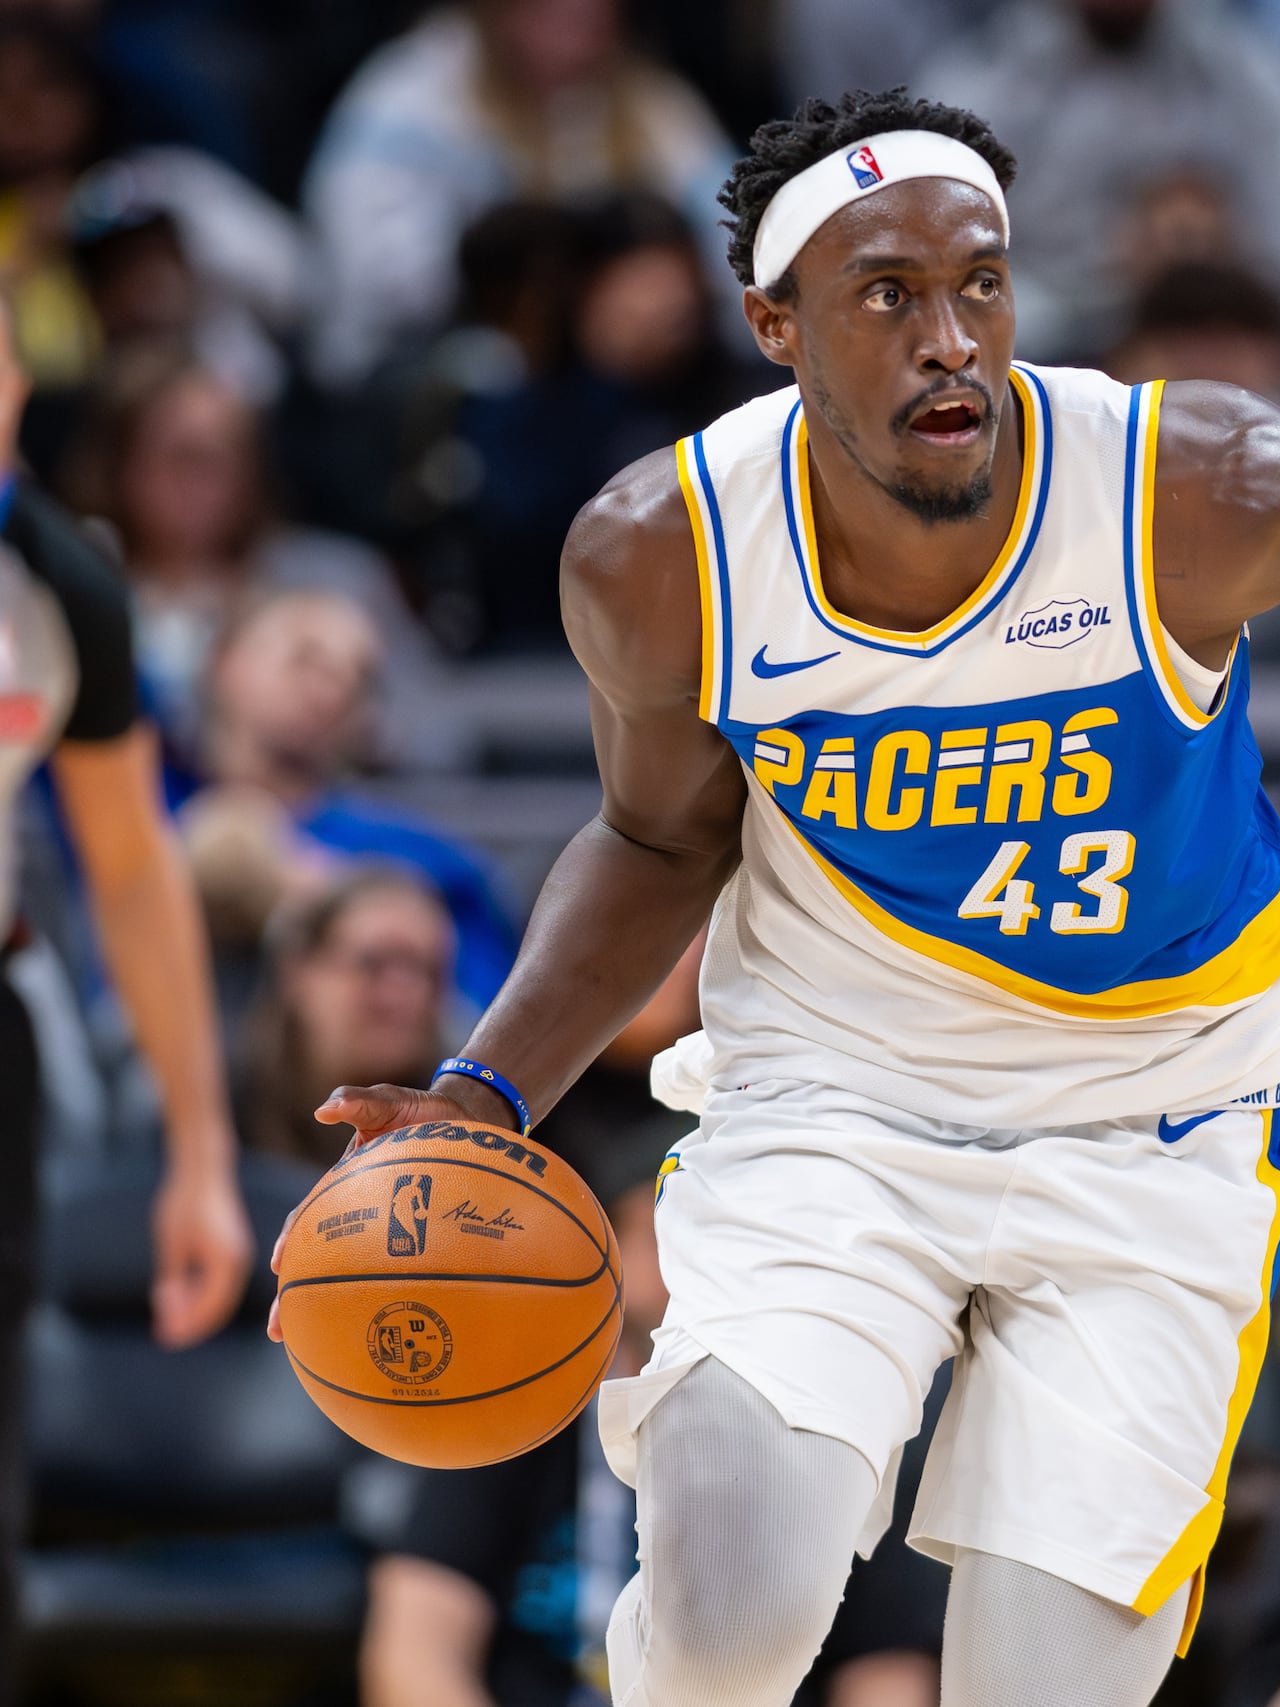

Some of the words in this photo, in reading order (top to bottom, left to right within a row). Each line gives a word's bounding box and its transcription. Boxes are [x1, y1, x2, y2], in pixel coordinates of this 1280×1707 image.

[1005, 612, 1073, 644] LUCAS
[1079, 606, 1111, 628] OIL
[753, 706, 1120, 832] PACERS
[957, 829, 1137, 936] 43
